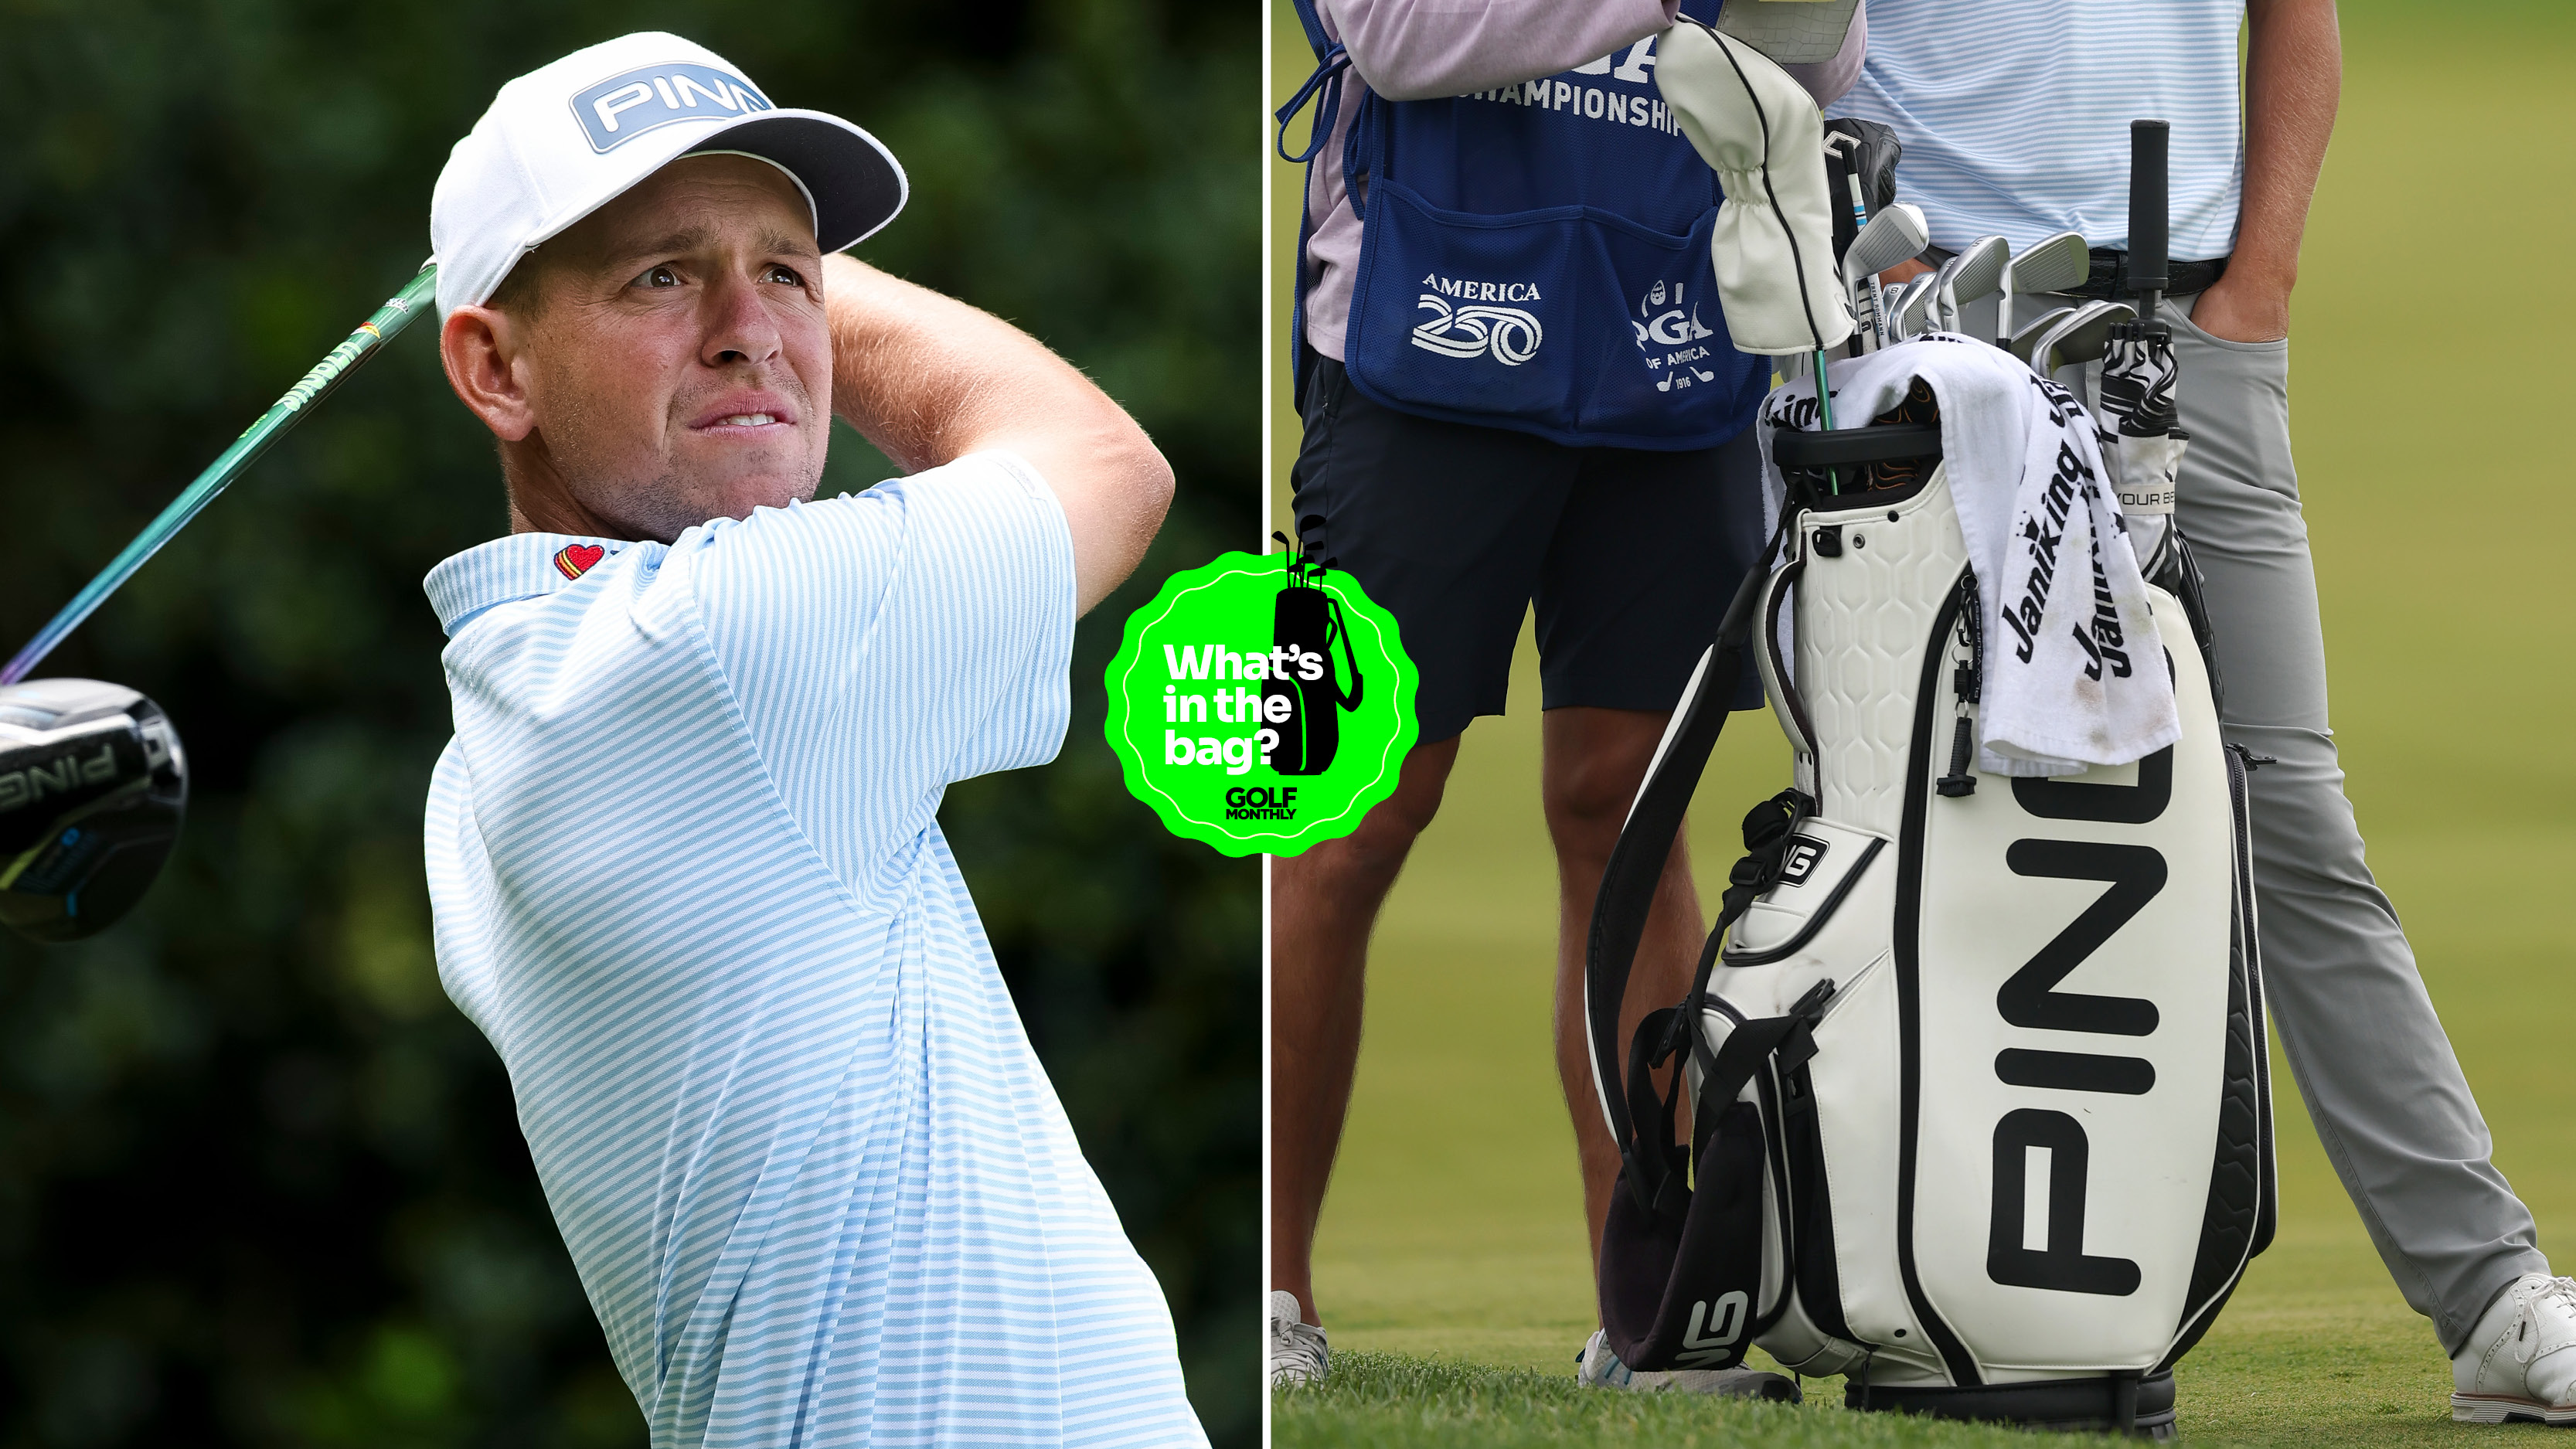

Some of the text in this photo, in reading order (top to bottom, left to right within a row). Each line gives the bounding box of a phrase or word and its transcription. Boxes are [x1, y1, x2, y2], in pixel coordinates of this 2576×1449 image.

[1458, 78, 1683, 137] AMPIONSHI
[1422, 273, 1542, 302] AMERICA
[1411, 294, 1543, 366] 250
[1645, 345, 1710, 369] OF AMERICA
[1675, 376, 1692, 390] 1916
